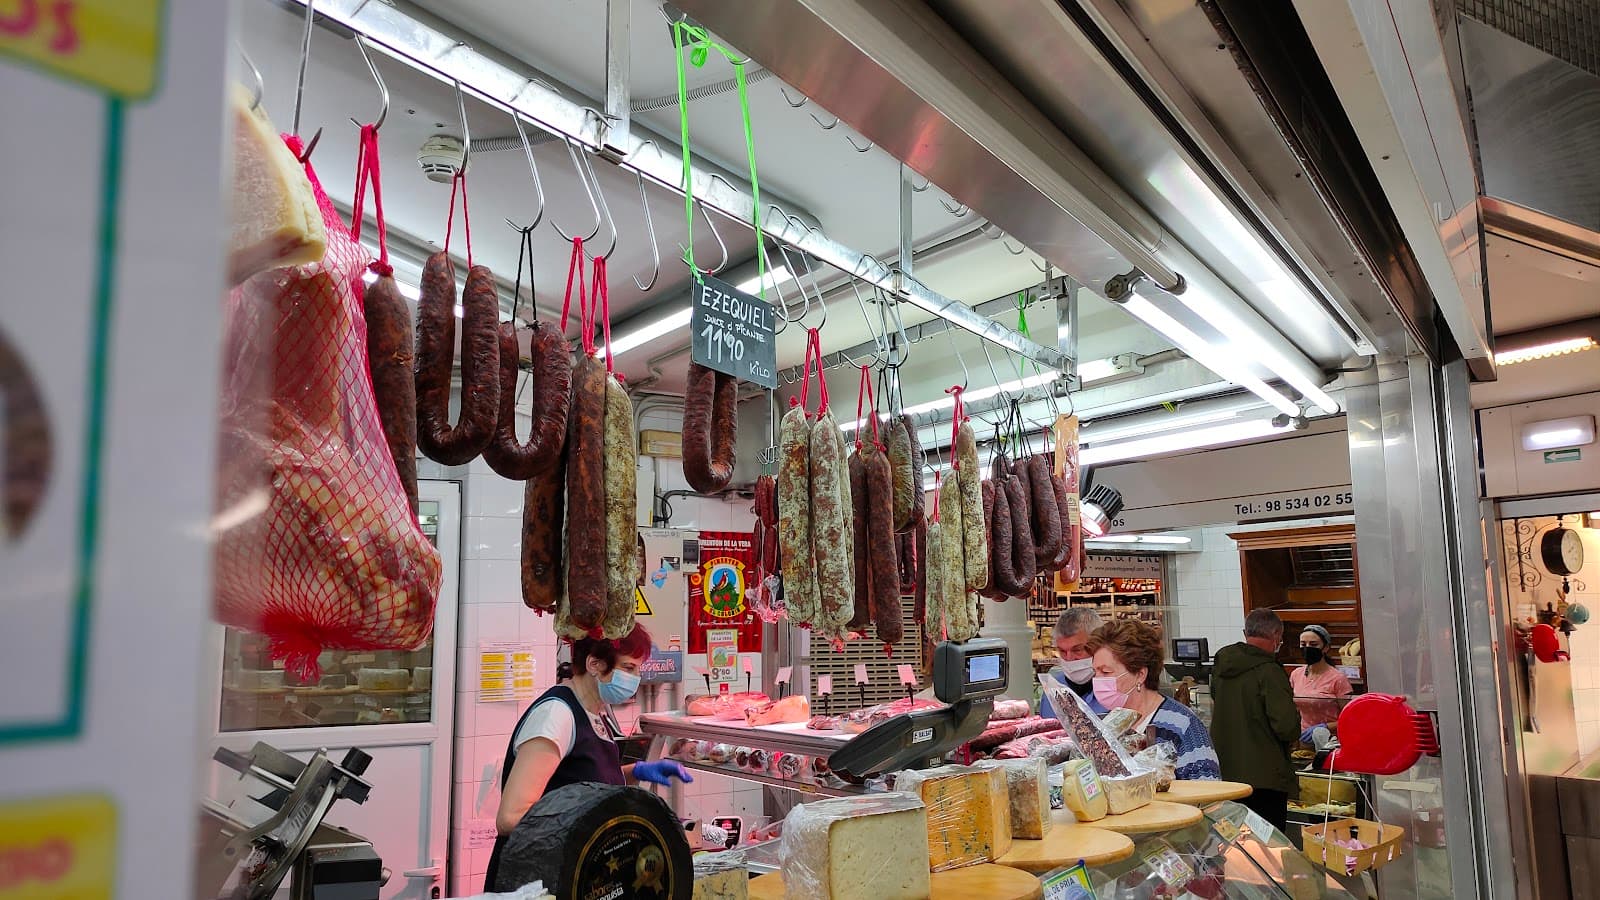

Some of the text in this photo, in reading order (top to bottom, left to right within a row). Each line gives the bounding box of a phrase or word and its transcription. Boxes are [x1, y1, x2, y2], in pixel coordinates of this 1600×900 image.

[701, 285, 772, 332] EZEQUIEL
[1234, 492, 1353, 515] Tel.: 98 534 02 55
